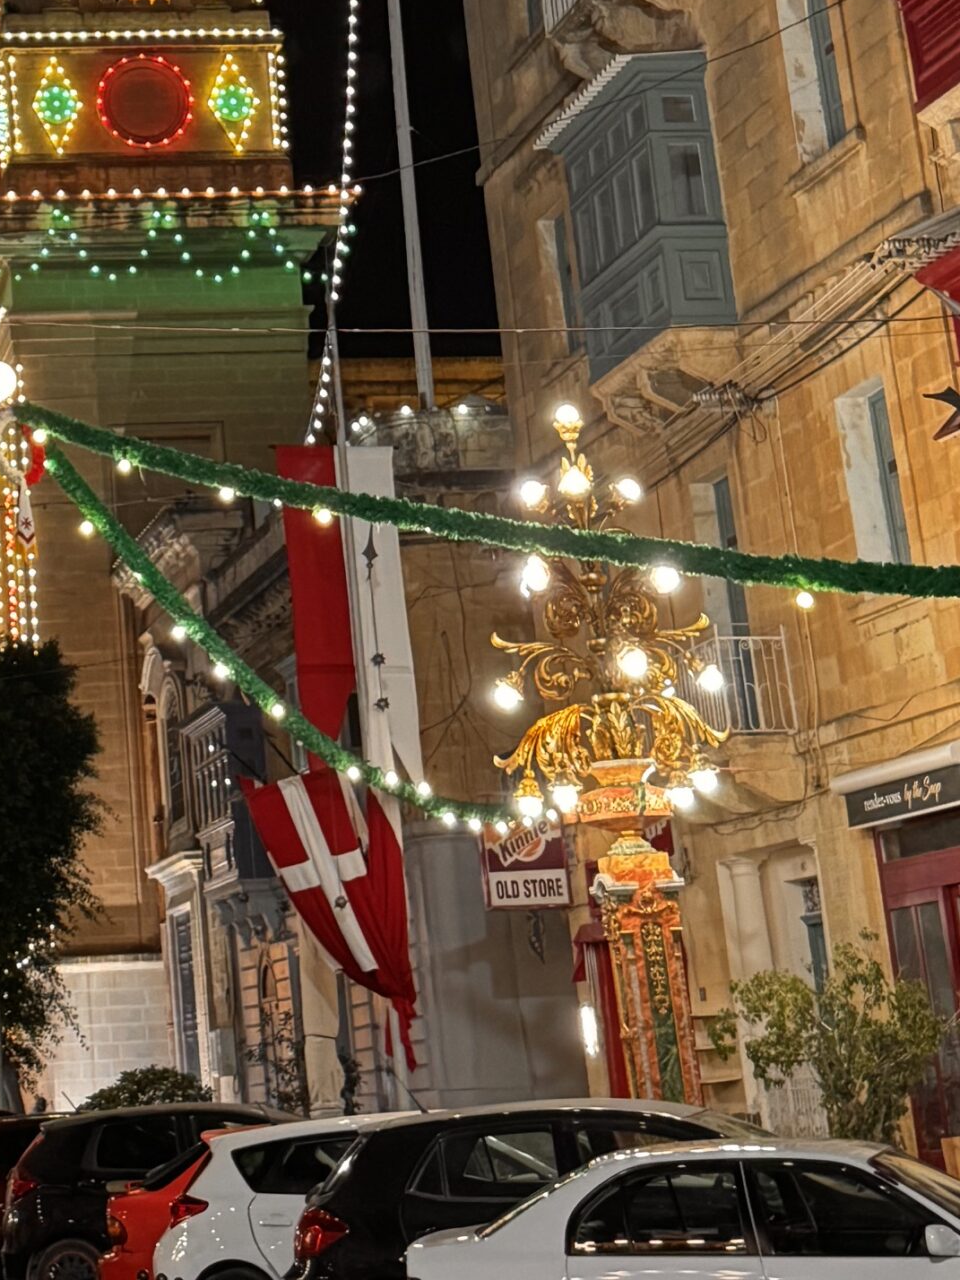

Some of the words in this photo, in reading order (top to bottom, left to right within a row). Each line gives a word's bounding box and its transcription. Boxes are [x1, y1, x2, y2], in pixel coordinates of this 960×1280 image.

[903, 783, 913, 810] by
[498, 820, 548, 862] Kinnie
[496, 878, 520, 900] OLD
[523, 877, 564, 898] STORE
